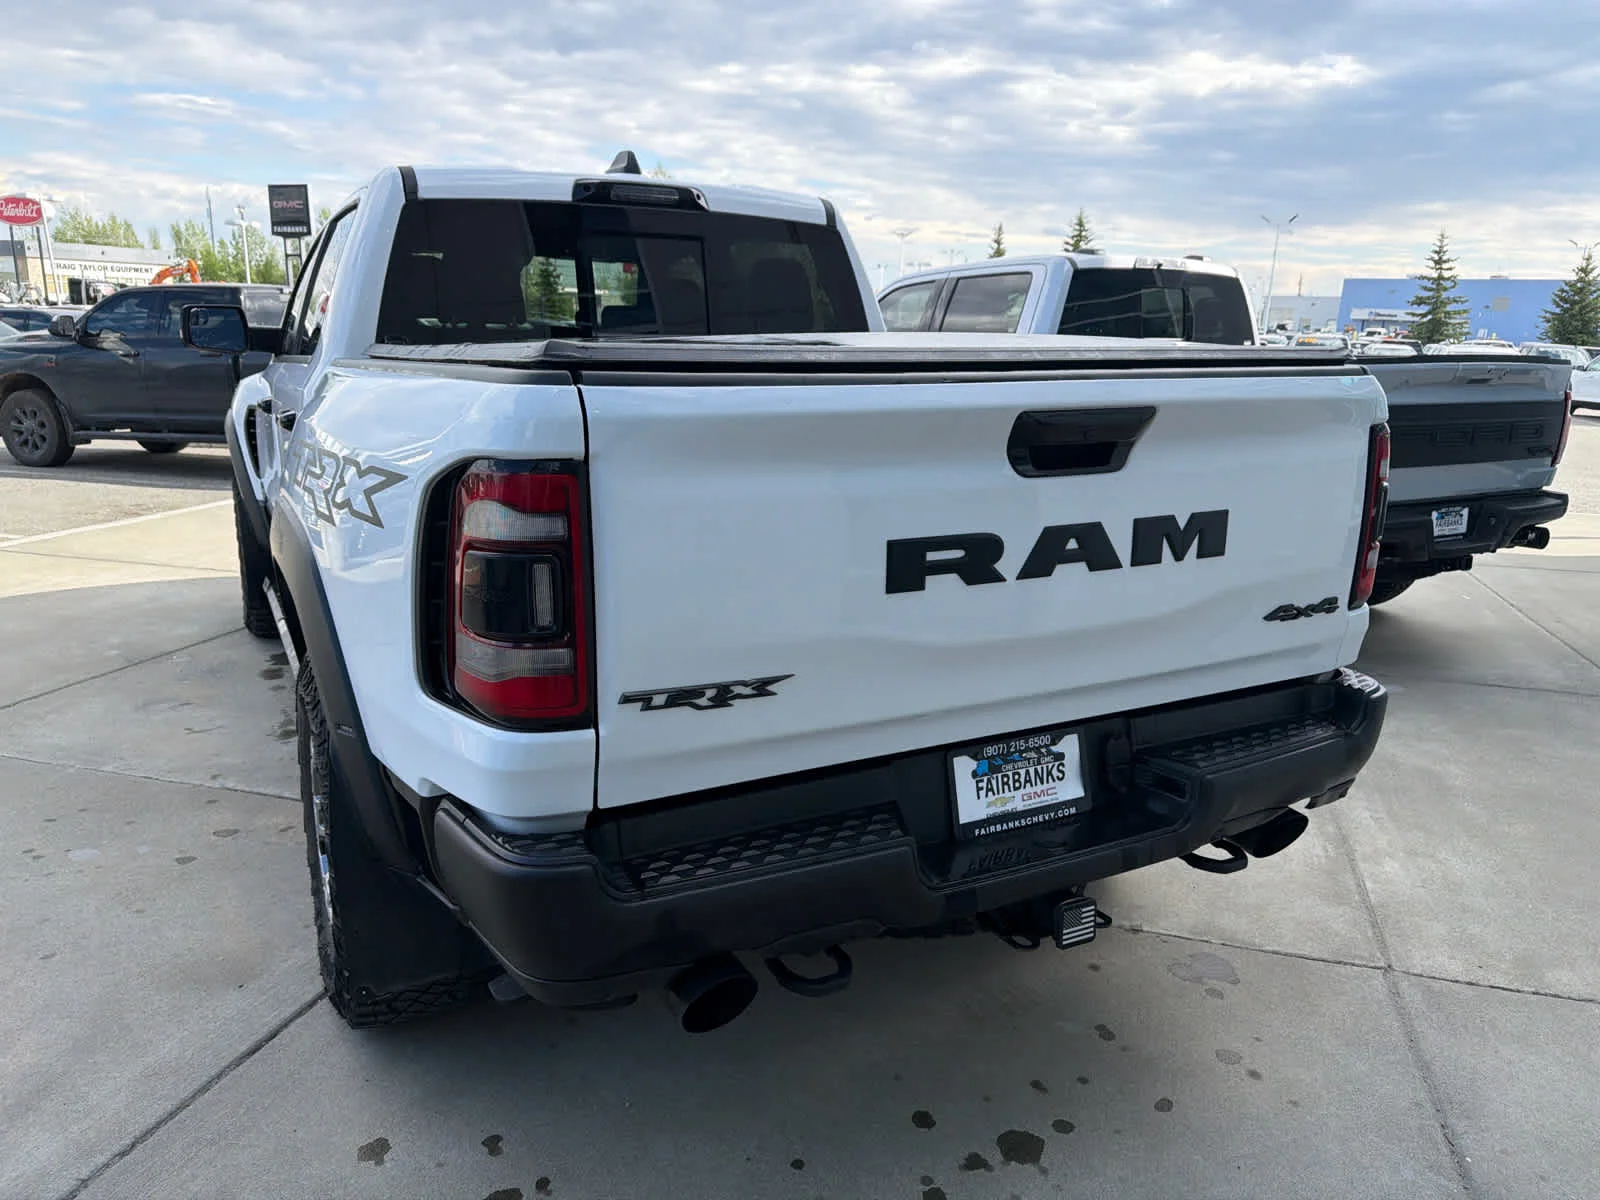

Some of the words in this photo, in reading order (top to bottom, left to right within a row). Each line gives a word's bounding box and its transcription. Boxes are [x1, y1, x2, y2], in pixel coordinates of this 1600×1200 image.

[80, 263, 108, 272] TAYLOR
[110, 263, 153, 274] EQUIPMENT
[885, 509, 1229, 594] RAM
[618, 674, 795, 712] TRX
[983, 743, 1008, 758] (907)
[1009, 735, 1051, 752] 215-6500
[1001, 758, 1038, 772] CHEVROLET
[1040, 754, 1055, 763] GMC
[975, 762, 1066, 800] FAIRBANKS
[1021, 786, 1057, 801] GMC
[974, 806, 1077, 837] FAIRBANKSCHEVY.COM
